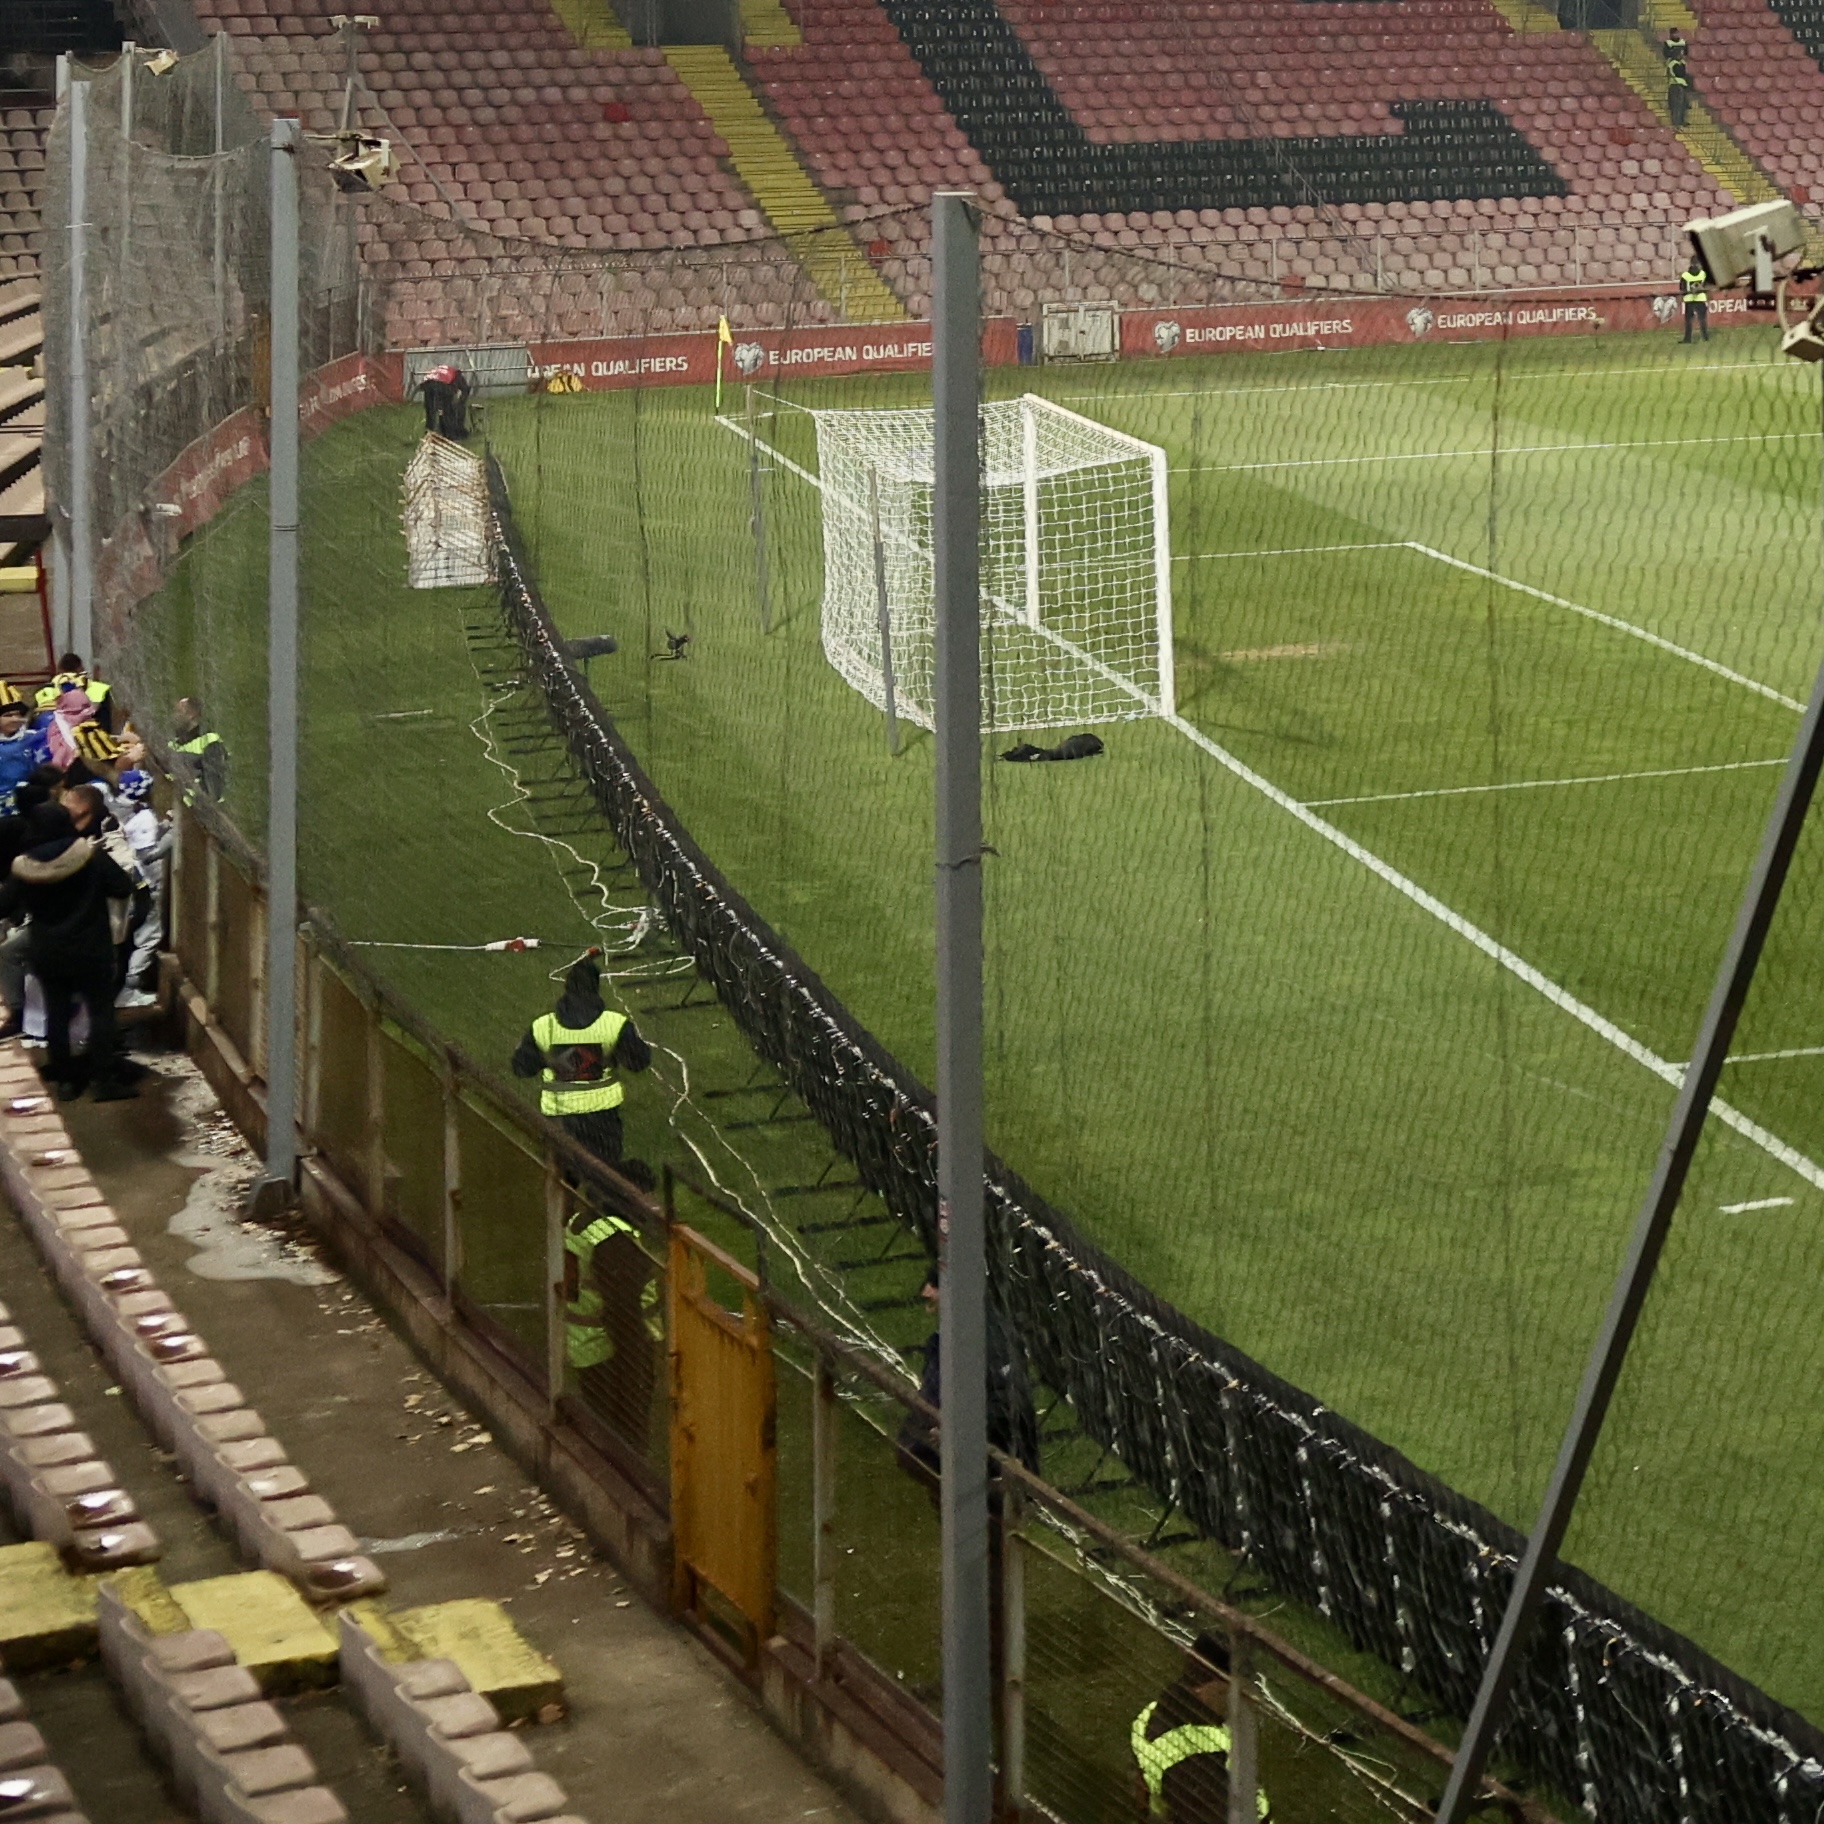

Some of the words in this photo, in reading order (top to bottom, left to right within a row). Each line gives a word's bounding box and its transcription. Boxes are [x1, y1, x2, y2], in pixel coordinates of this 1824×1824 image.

[1437, 311, 1513, 329] EUROPEAN
[1516, 306, 1597, 326] QUALIFIERS
[1185, 324, 1265, 343] EUROPEAN
[1269, 319, 1353, 339] QUALIFIERS
[769, 346, 858, 366] EUROPEAN
[862, 342, 933, 360] QUALIFIE
[590, 355, 688, 377] QUALIFIERS
